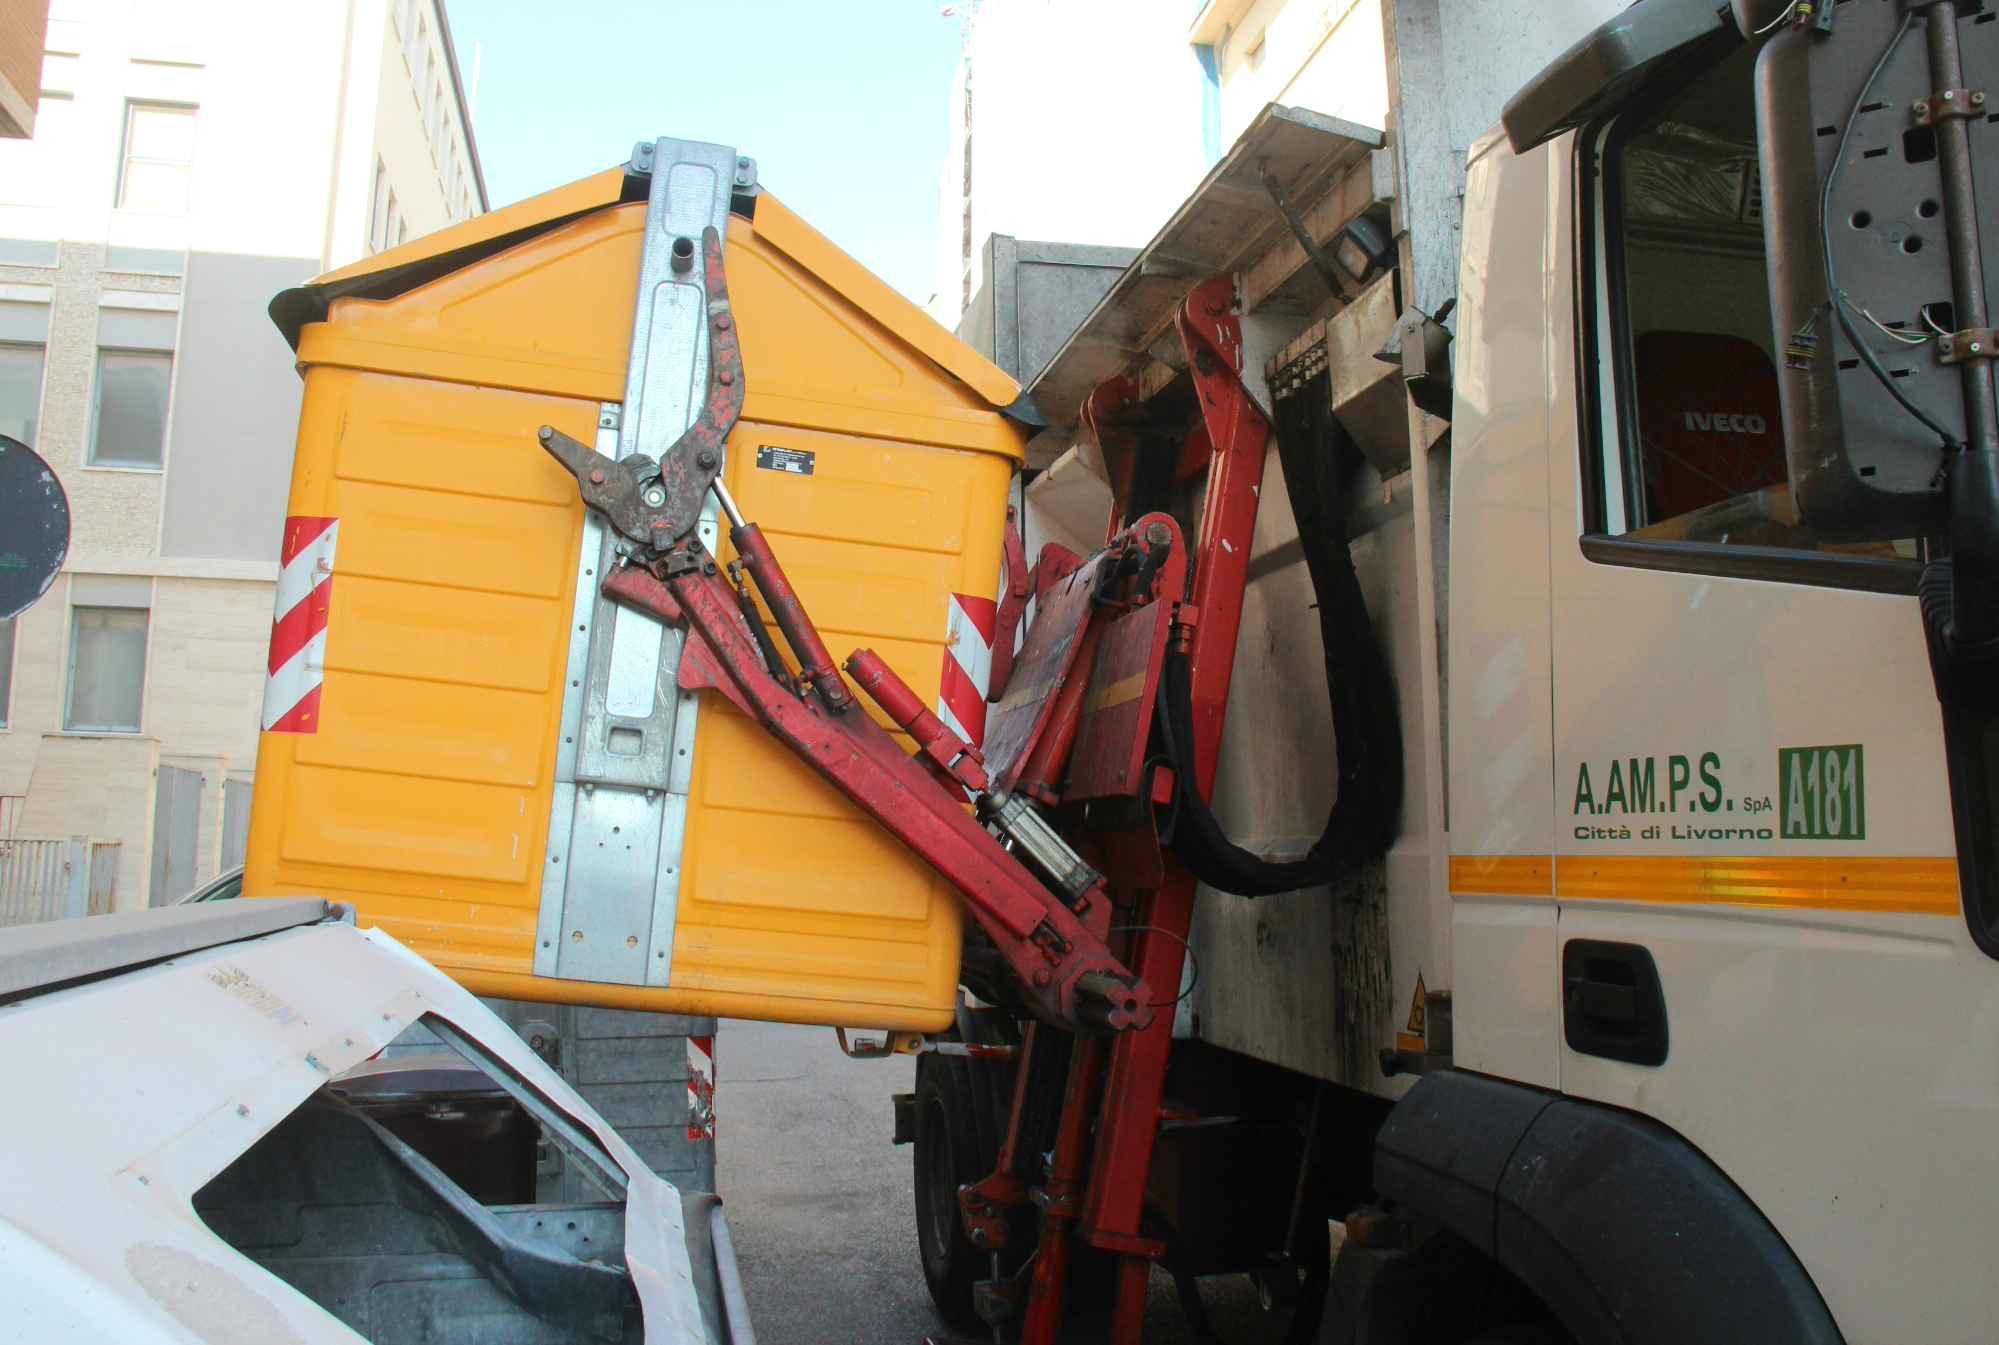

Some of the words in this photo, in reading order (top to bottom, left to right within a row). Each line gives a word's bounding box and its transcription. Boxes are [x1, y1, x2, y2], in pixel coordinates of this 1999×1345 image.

[1684, 412, 1766, 433] IVECO
[1573, 751, 1734, 815] A.AM.P.S.
[1743, 796, 1774, 815] SpA
[1786, 749, 1859, 836] A181
[1573, 825, 1632, 840] Città
[1641, 826, 1661, 840] di
[1671, 826, 1774, 840] Livorno
